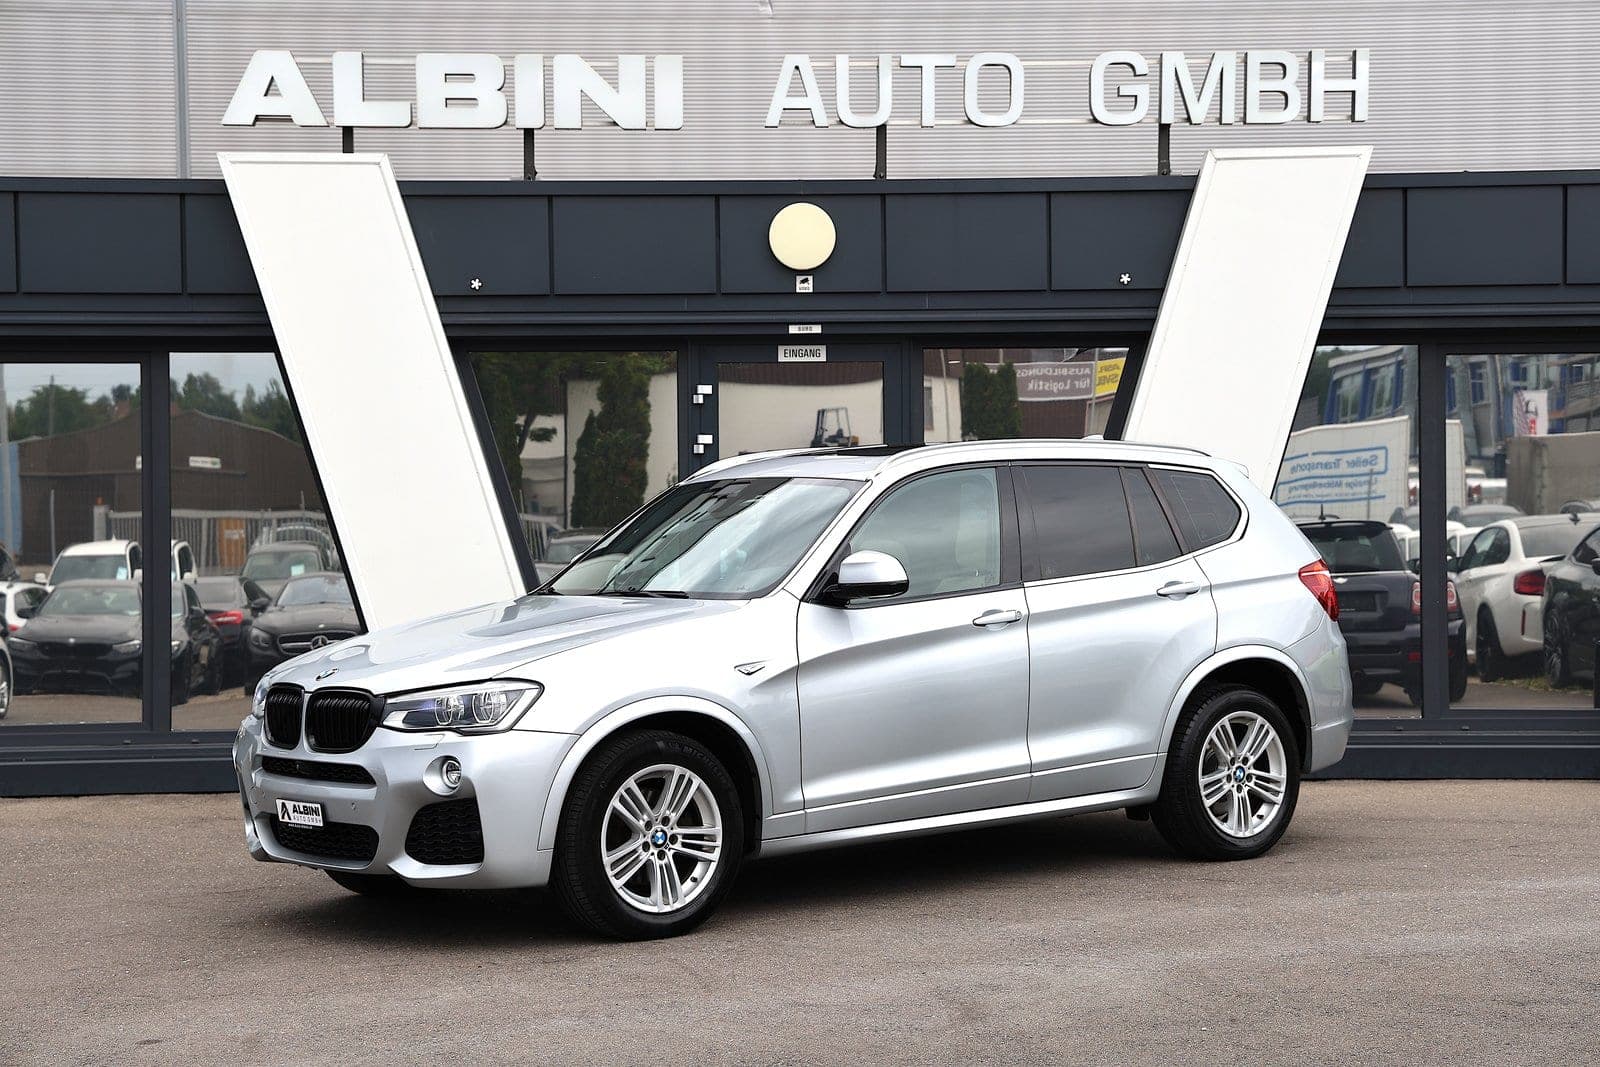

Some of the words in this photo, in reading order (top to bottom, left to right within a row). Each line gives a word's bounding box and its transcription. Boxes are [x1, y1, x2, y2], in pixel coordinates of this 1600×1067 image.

[222, 50, 684, 130] ALBINI
[765, 53, 1025, 128] AUTO
[1089, 48, 1370, 125] GMBH
[783, 348, 821, 358] EINGANG
[293, 804, 320, 816] ALBINI
